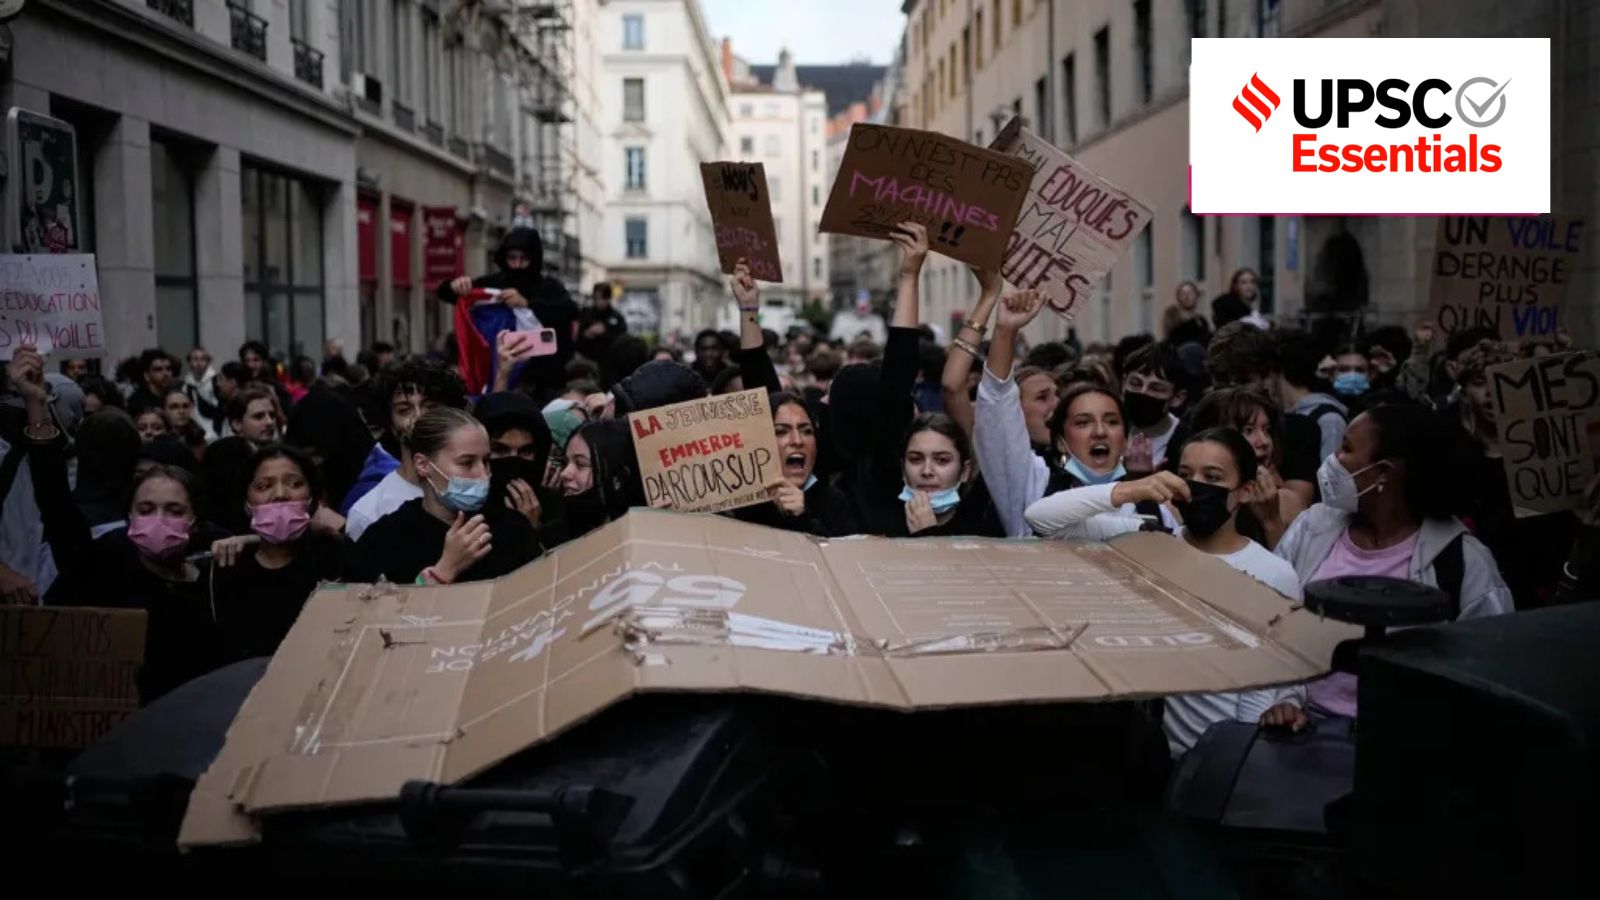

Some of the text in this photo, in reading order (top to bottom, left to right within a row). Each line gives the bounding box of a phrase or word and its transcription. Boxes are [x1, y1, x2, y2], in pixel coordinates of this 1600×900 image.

[853, 127, 1025, 192] ON N'EST PAS
[911, 162, 955, 193] DES
[849, 169, 999, 232] MACHINES
[1016, 202, 1078, 261] MAL
[1445, 216, 1584, 253] UN VOILE
[1437, 251, 1564, 284] DERANGE
[1479, 282, 1538, 305] PLUS
[45, 321, 101, 349] VOILE
[1493, 354, 1599, 413] MES
[633, 393, 763, 439] LA JEUNESSE
[658, 432, 744, 467] EMMERDE
[1505, 412, 1584, 464] SONT
[645, 448, 771, 508] PARCOURSUP
[1515, 461, 1584, 501] QUE
[431, 563, 632, 658] INNOVATION
[425, 659, 474, 673] OF
[15, 710, 131, 747] MINISTR
